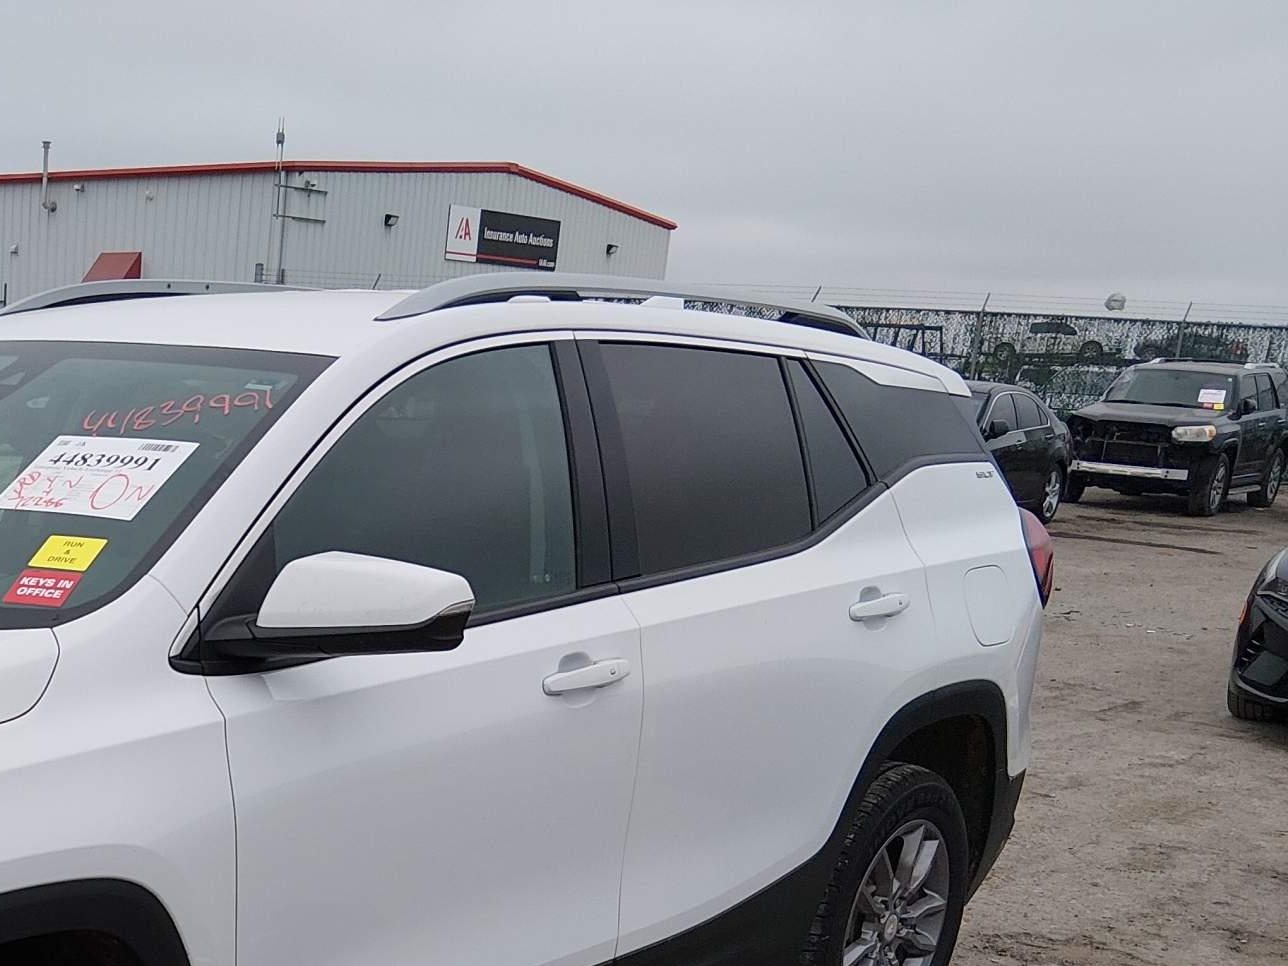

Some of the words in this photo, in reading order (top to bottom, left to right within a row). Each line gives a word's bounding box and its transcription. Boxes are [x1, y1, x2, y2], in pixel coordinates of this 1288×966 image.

[484, 226, 513, 242] Insurance
[514, 231, 528, 244] Auto
[528, 233, 554, 248] Auctions
[48, 451, 162, 471] 44839991
[63, 540, 85, 548] RUN
[47, 555, 78, 564] DRIVE
[19, 576, 57, 588] KEYS
[57, 579, 74, 589] IN
[16, 586, 65, 599] OFFICE
